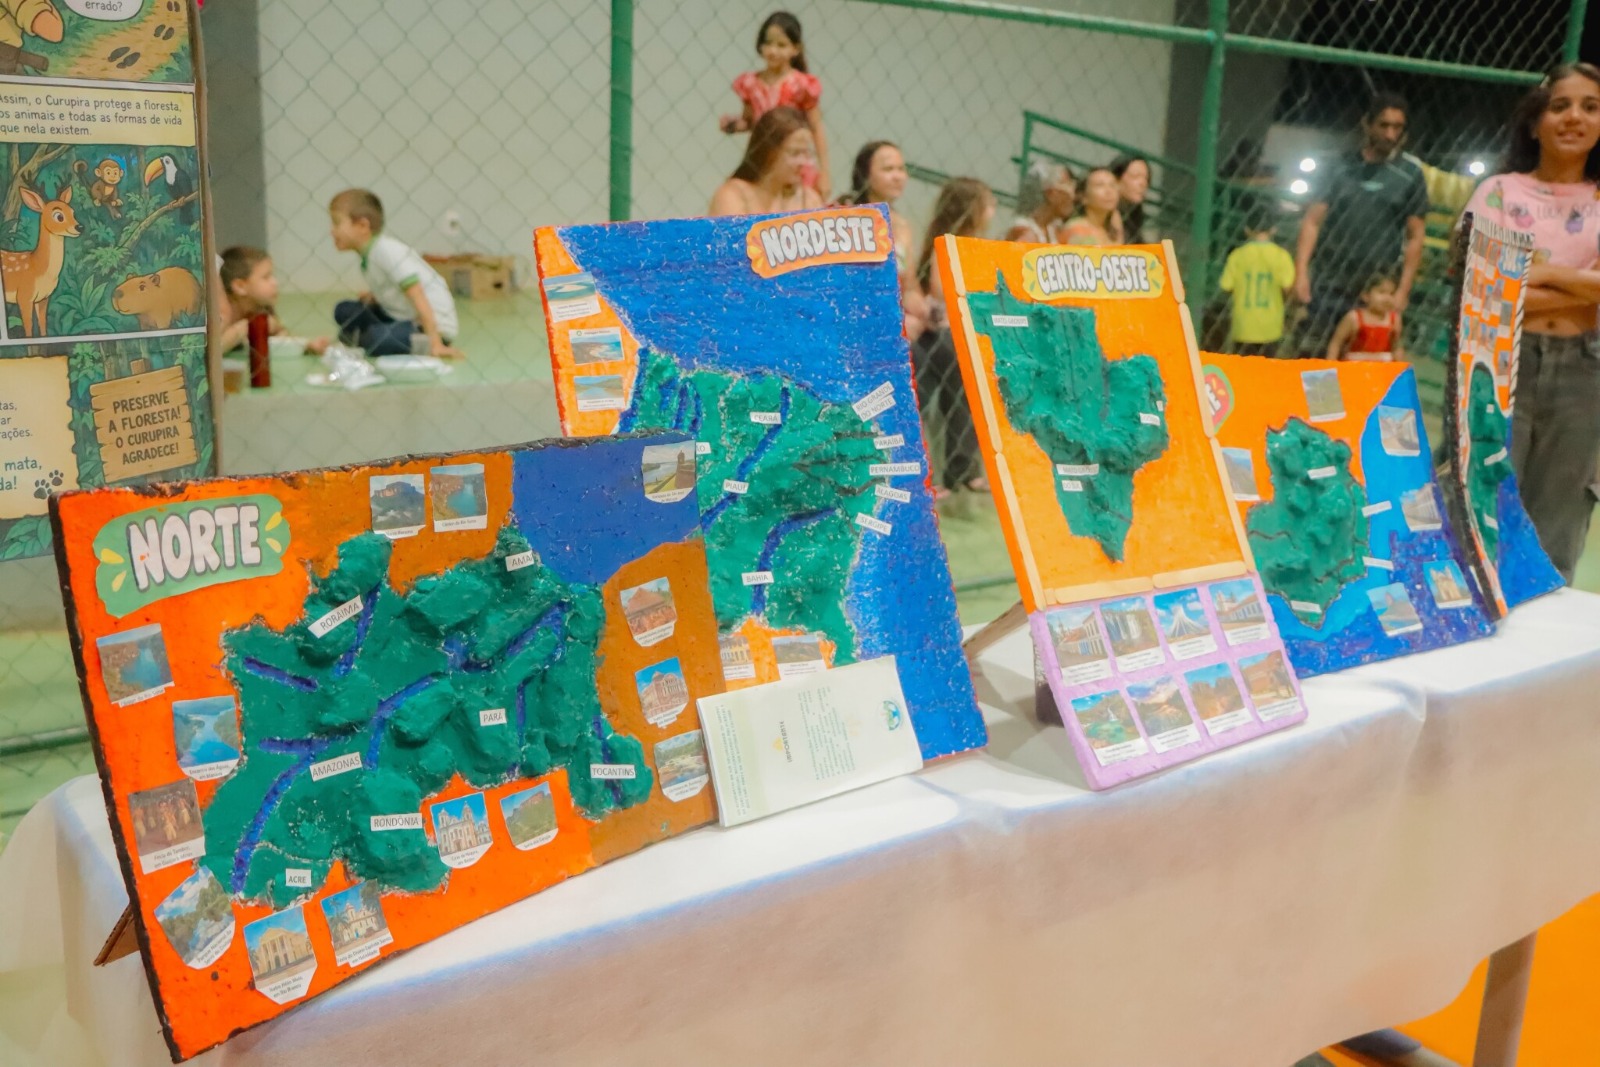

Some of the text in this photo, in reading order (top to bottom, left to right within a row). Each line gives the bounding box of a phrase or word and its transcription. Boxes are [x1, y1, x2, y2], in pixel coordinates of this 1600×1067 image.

[85, 0, 123, 11] errado?
[35, 97, 42, 105] o
[45, 94, 90, 109] Curupira
[93, 99, 132, 112] protege
[135, 102, 141, 110] a
[144, 100, 182, 112] floresta,
[14, 110, 56, 120] animais
[59, 112, 65, 121] e
[68, 111, 97, 122] todas
[100, 114, 111, 123] as
[114, 112, 147, 124] formas
[150, 114, 161, 125] de
[164, 115, 182, 125] vida
[0, 123, 92, 136] que nela existem.
[760, 216, 877, 268] NORDESTE
[1036, 252, 1150, 296] CENTRO-OESTE
[112, 391, 170, 414] PRESERVE
[871, 397, 893, 412] NORTE
[108, 405, 181, 433] A FLORESTA!
[0, 427, 33, 440] ações.
[115, 425, 180, 449] O CURUPIRA
[122, 442, 180, 465] AGRADECE!
[4, 456, 42, 471] mata,
[870, 466, 920, 475] PERNAMBUCO
[876, 488, 908, 501] ALAGOAS
[860, 515, 888, 533] SERGIPE
[126, 502, 262, 592] NORTE
[746, 574, 769, 583] BAHIA
[319, 602, 360, 632] RORAIMA
[483, 712, 504, 722] PARÁ
[312, 755, 361, 779] AMAZONAS
[591, 767, 635, 777] TOCANTINS
[373, 815, 419, 828] RONDÔNIA
[288, 876, 307, 884] ACRE
